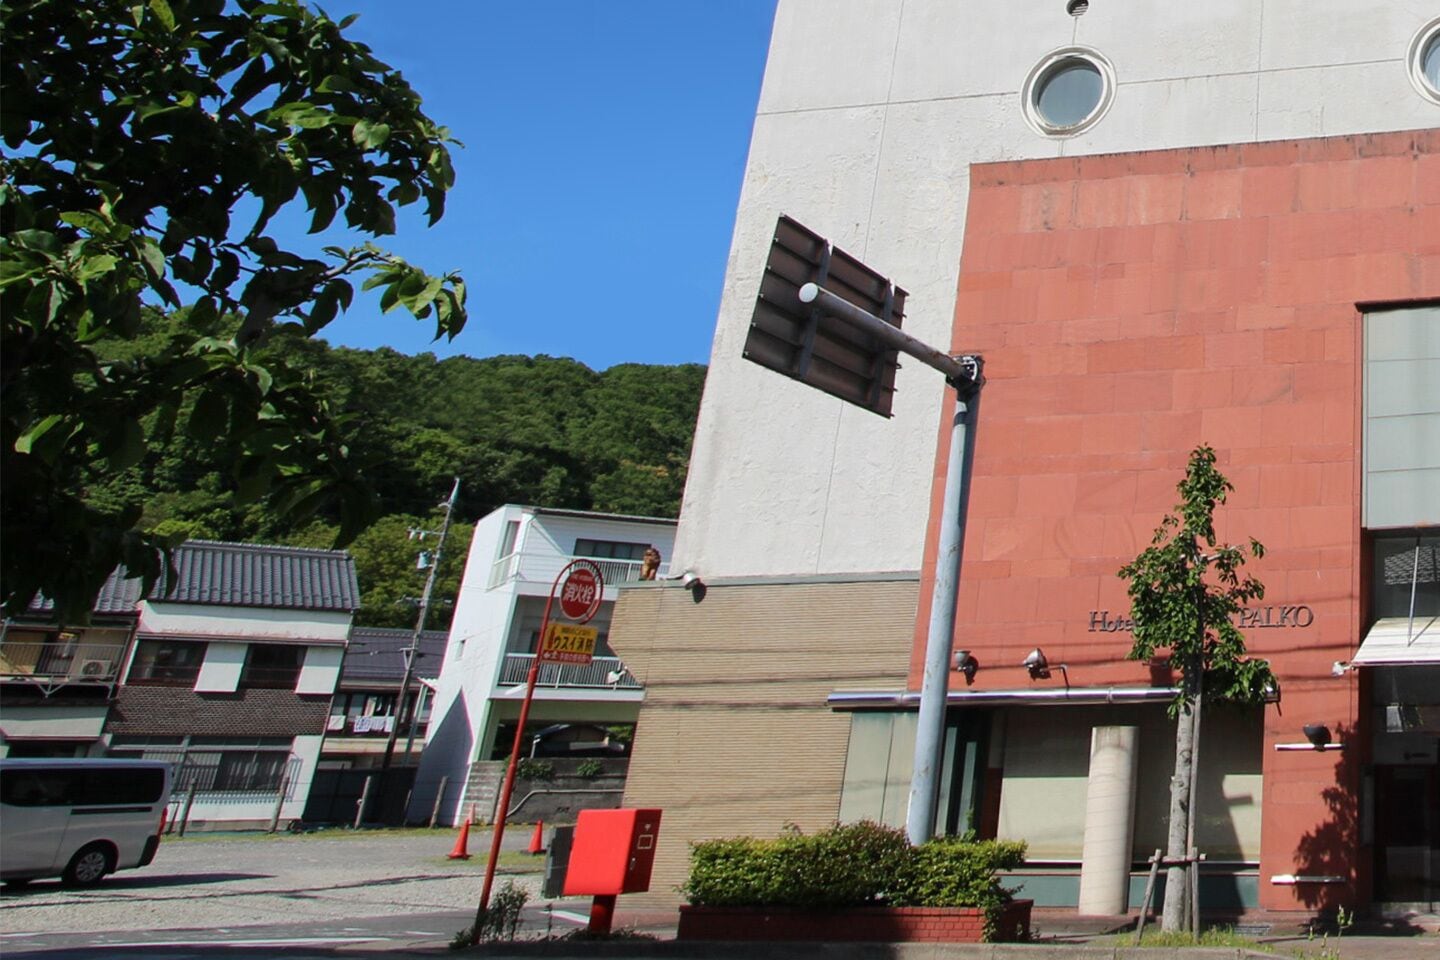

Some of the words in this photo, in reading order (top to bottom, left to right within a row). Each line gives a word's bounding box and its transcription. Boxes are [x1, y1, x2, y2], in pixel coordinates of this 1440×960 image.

[563, 582, 595, 605] 消火栓
[1088, 609, 1137, 633] Hote
[1238, 605, 1314, 629] PALKO
